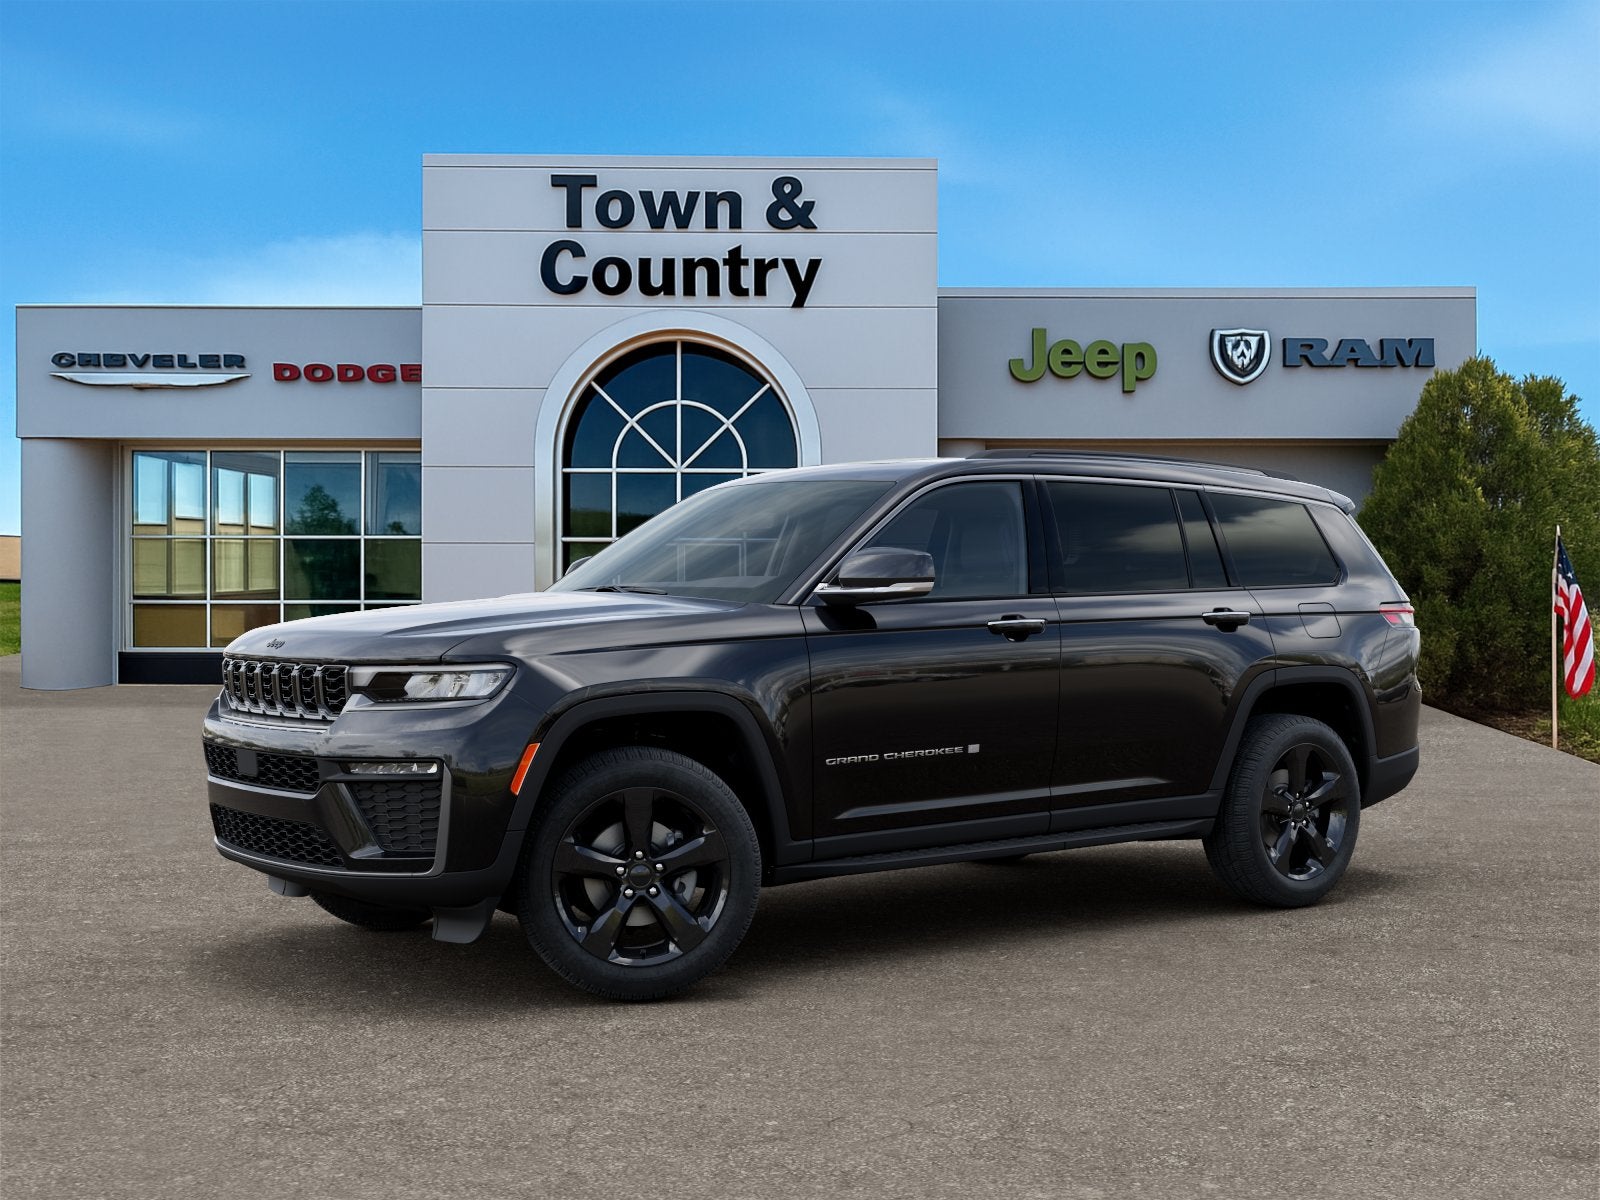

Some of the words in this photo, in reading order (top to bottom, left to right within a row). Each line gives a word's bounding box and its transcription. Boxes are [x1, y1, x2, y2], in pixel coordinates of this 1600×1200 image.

[551, 174, 742, 229] Town
[766, 176, 818, 230] &
[540, 239, 822, 308] Country
[273, 363, 422, 382] DODGE
[1009, 328, 1158, 393] Jeep
[1282, 338, 1435, 367] RAM
[825, 754, 879, 766] GRAND
[883, 746, 964, 760] CHEROKEE
